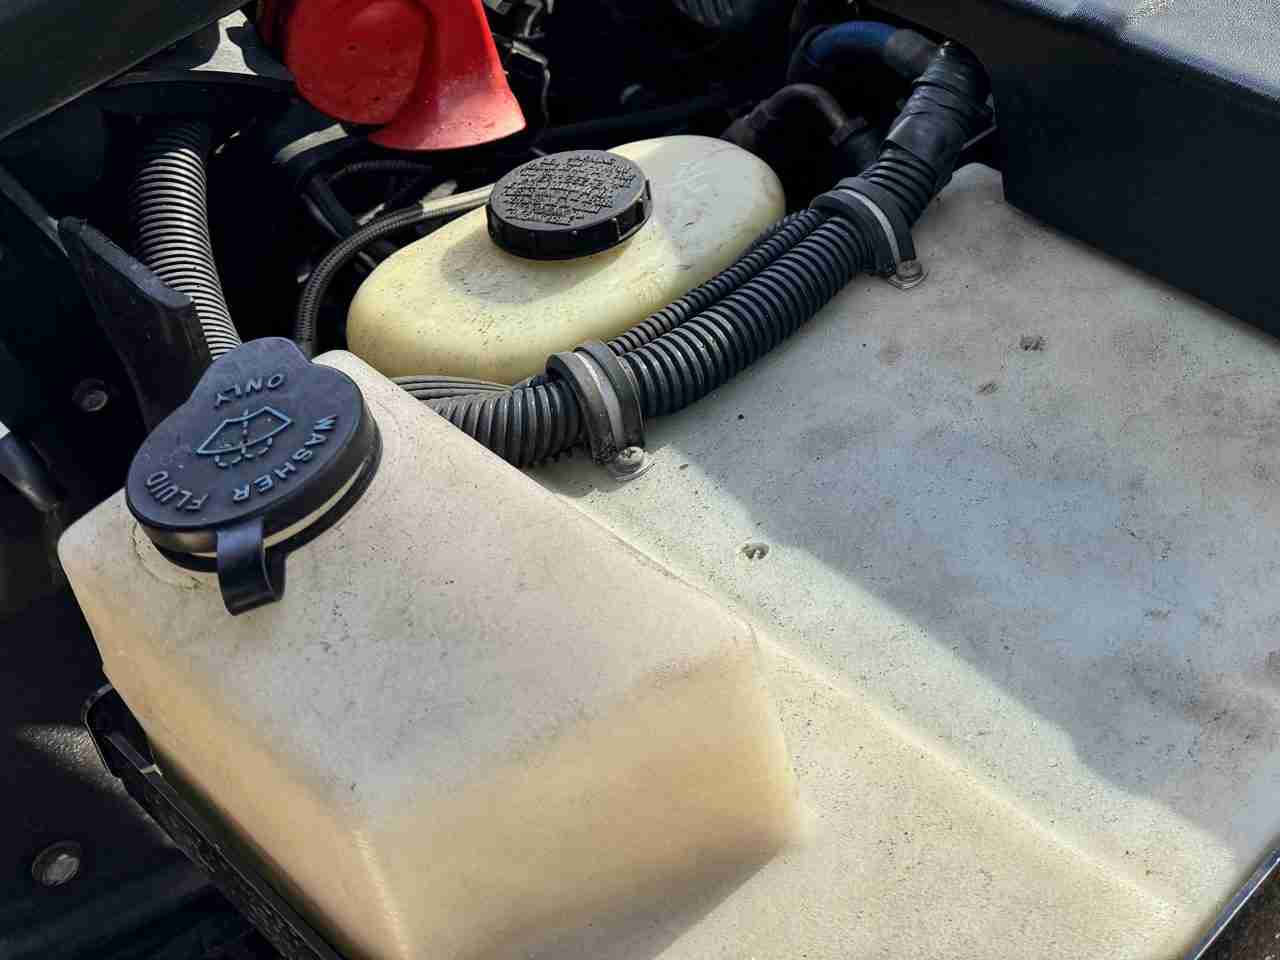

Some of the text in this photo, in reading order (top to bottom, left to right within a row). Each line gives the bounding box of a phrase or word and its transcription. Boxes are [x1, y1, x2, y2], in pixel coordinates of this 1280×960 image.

[214, 373, 285, 408] ONLY
[147, 415, 338, 512] WASHER FLUID
